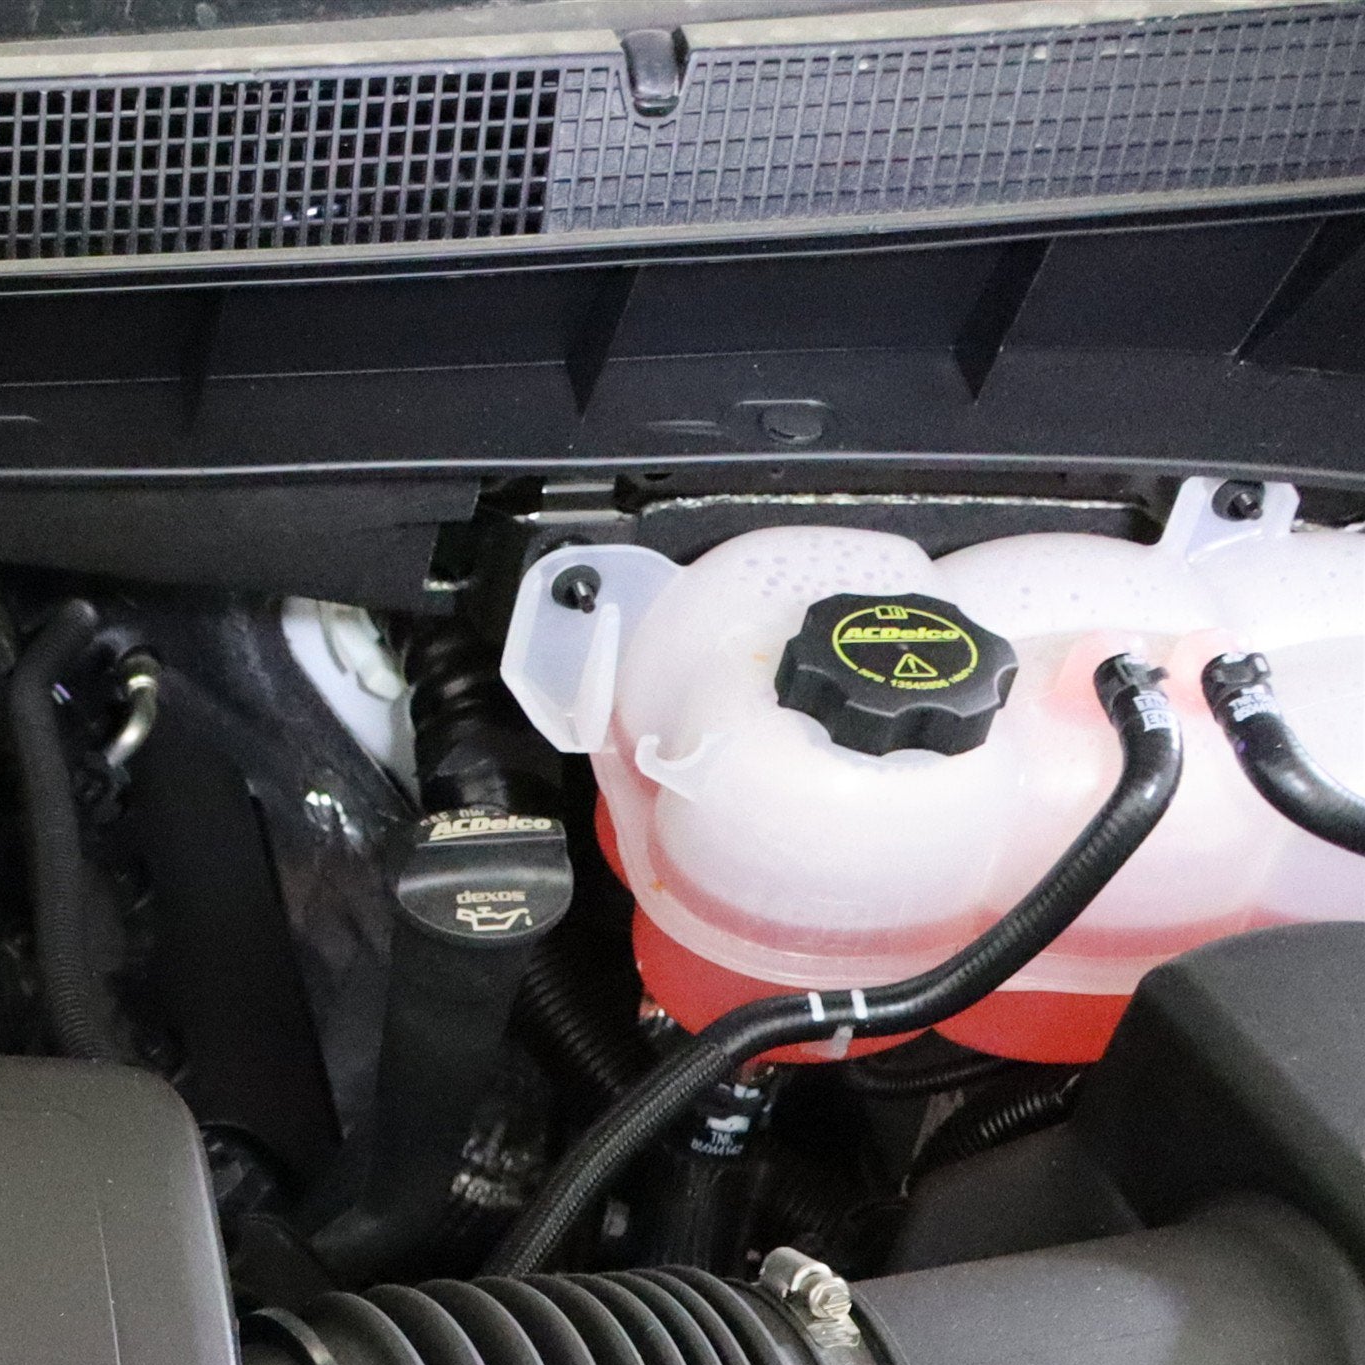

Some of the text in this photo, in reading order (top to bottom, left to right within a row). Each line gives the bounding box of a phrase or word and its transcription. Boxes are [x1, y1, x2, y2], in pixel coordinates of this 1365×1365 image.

[842, 627, 961, 640] ACDelco
[430, 815, 552, 837] ACDelco
[456, 889, 527, 905] dexos
